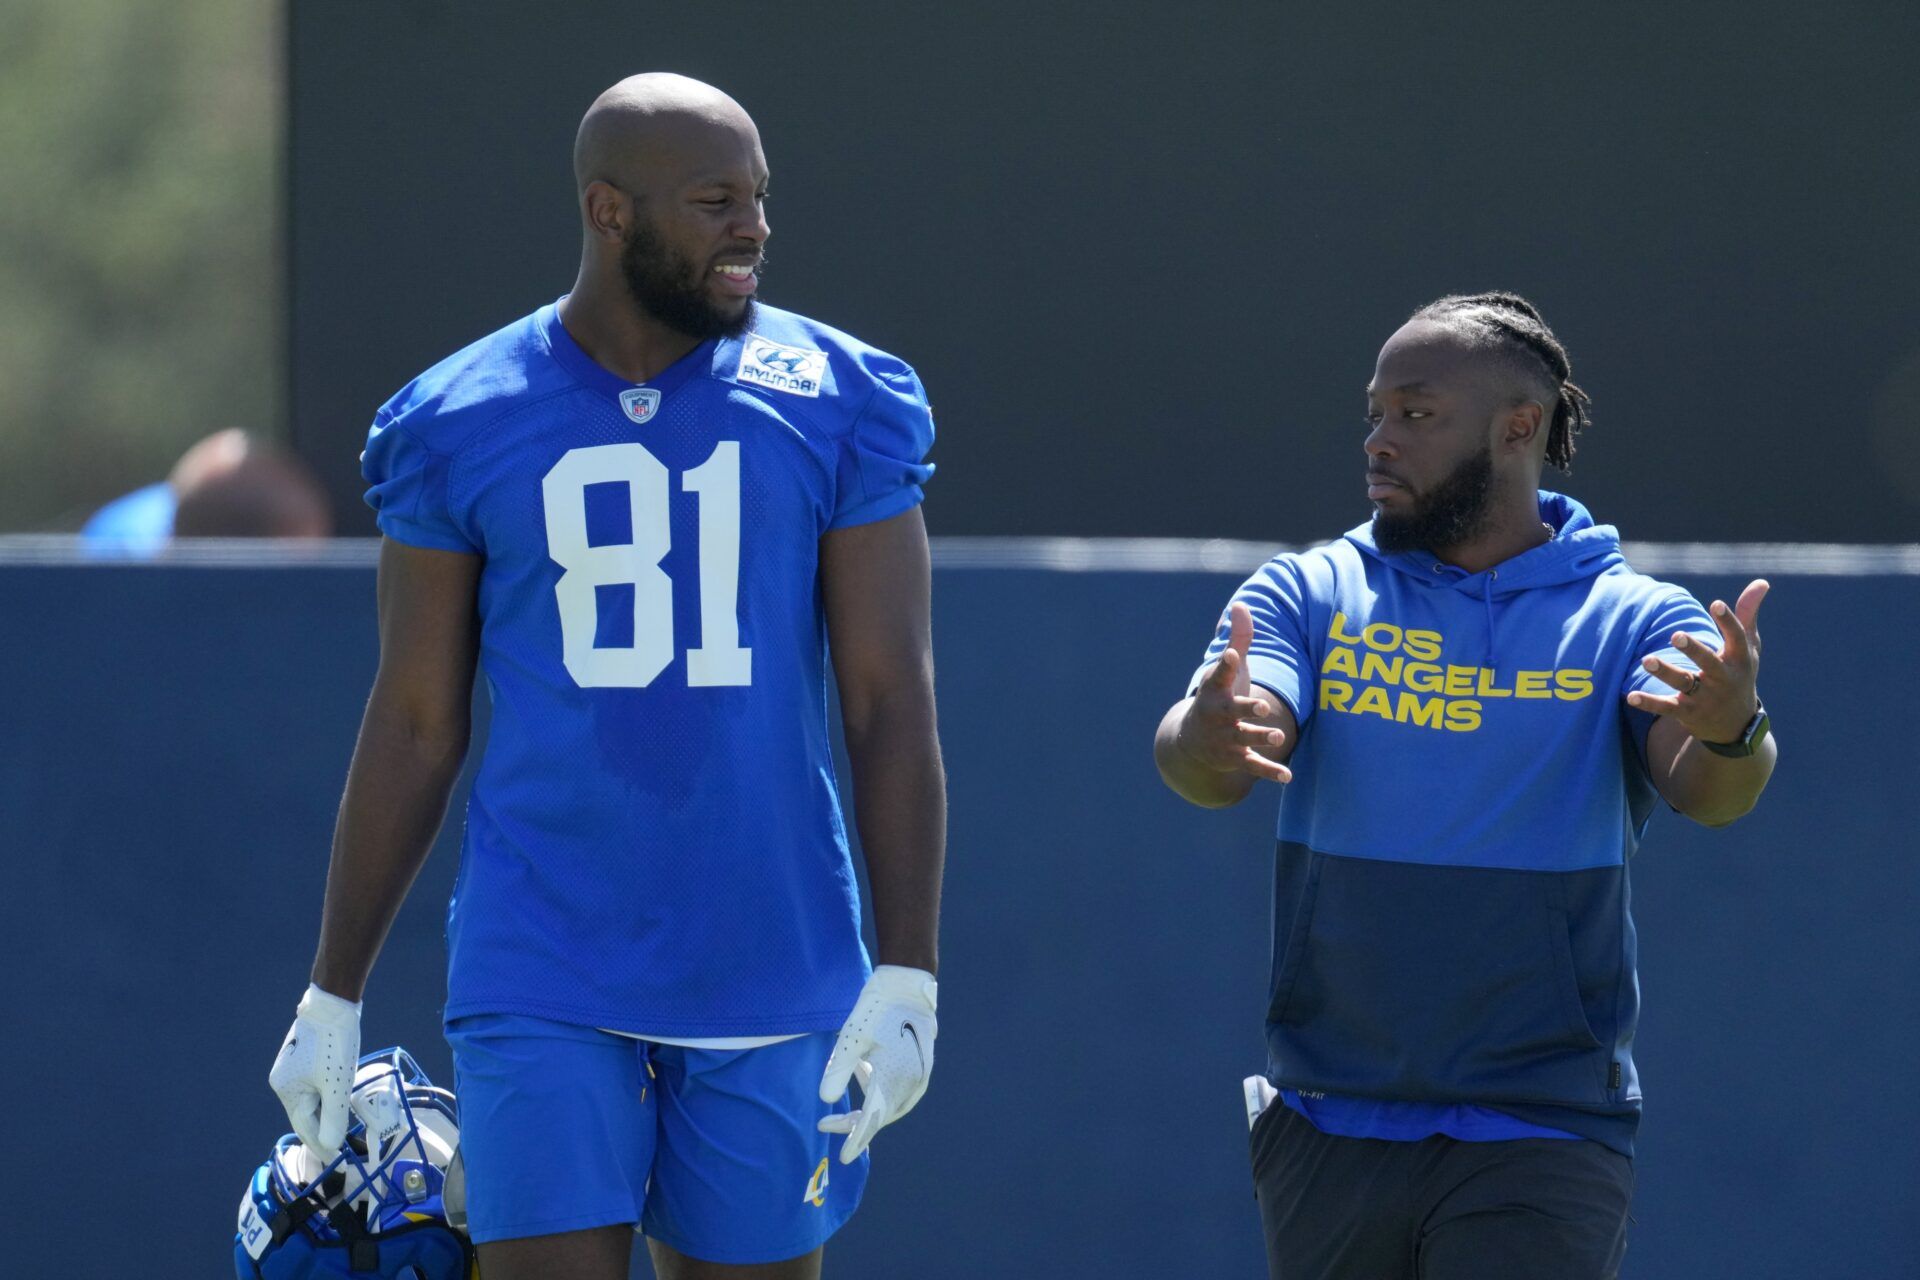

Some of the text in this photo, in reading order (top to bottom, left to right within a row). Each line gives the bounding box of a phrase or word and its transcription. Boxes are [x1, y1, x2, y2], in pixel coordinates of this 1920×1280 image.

[743, 365, 817, 392] HYUNDAI
[633, 404, 650, 416] NFL
[542, 441, 752, 688] 81
[1328, 611, 1443, 661] LOS
[1321, 646, 1594, 701] ANGELES
[1319, 679, 1483, 732] RAMS
